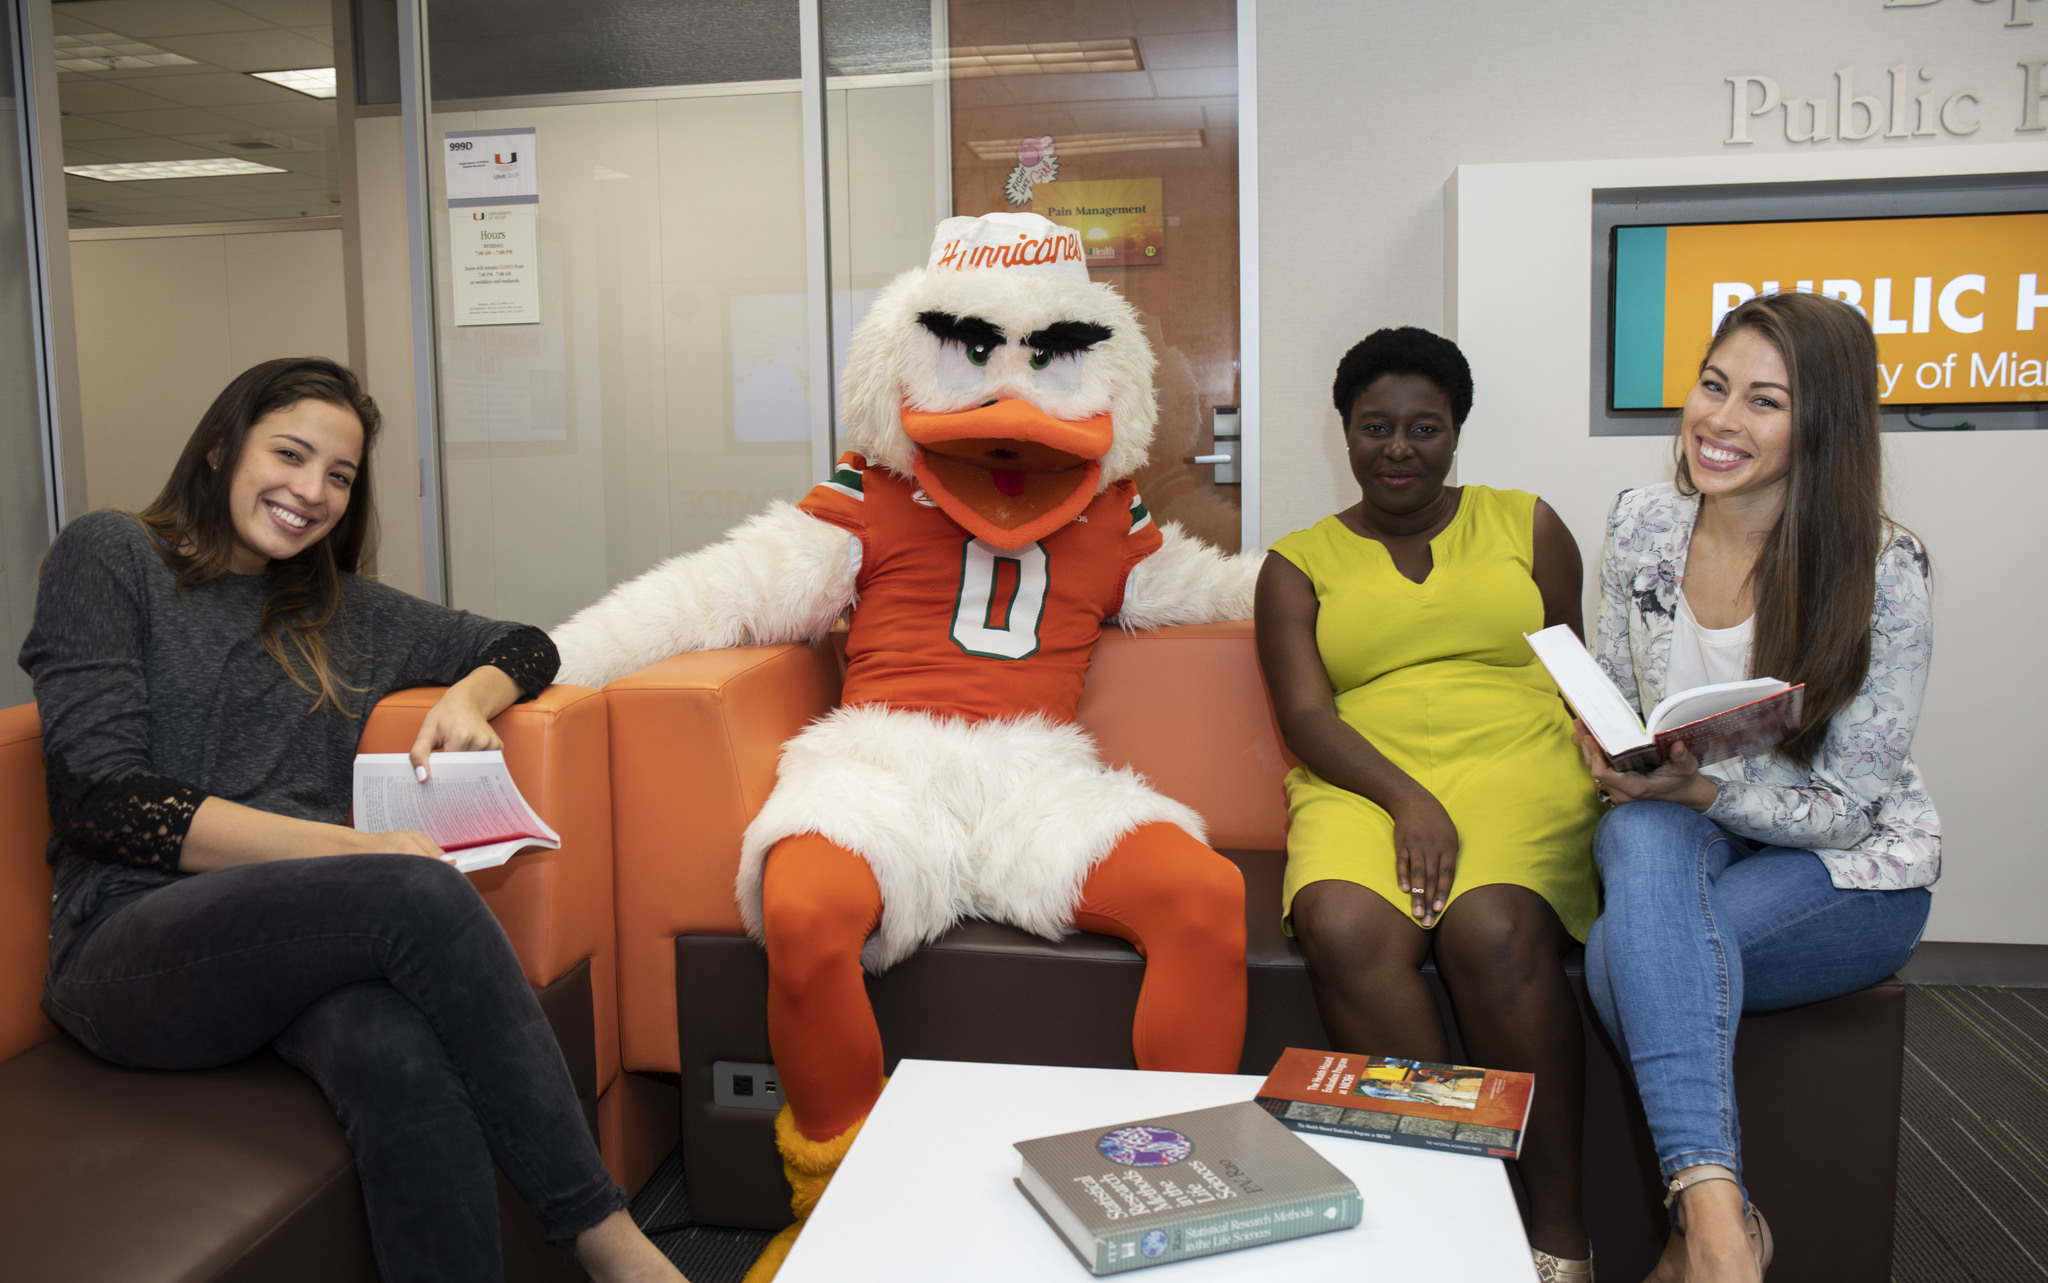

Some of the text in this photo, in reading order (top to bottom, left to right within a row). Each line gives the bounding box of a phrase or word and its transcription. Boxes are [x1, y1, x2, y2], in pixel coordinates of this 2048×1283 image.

[1723, 63, 1981, 145] Public
[449, 141, 473, 151] 999D
[1012, 166, 1026, 192] FIGHT
[1020, 177, 1031, 195] LIKE
[1030, 160, 1054, 184] Girl
[1048, 204, 1147, 218] Pain Management
[480, 230, 506, 240] Hours
[937, 233, 1082, 271] Hurricanes
[1916, 353, 1958, 389] of
[1970, 352, 2048, 388] Mia
[1306, 1056, 1335, 1091] The Health Hazard
[1321, 1058, 1349, 1093] Evaluation Program
[1338, 1074, 1356, 1090] NIOSH
[1188, 1160, 1238, 1200] Sciences
[1219, 1158, 1244, 1178] Rao
[1073, 1174, 1129, 1220] Statistical
[1100, 1172, 1151, 1216] Research
[1122, 1169, 1174, 1212] Methods
[1160, 1180, 1194, 1208] in the
[1187, 1182, 1216, 1204] Life
[1185, 1206, 1314, 1240] Statistical Research Methods
[1185, 1229, 1272, 1252] in the Life Sciences
